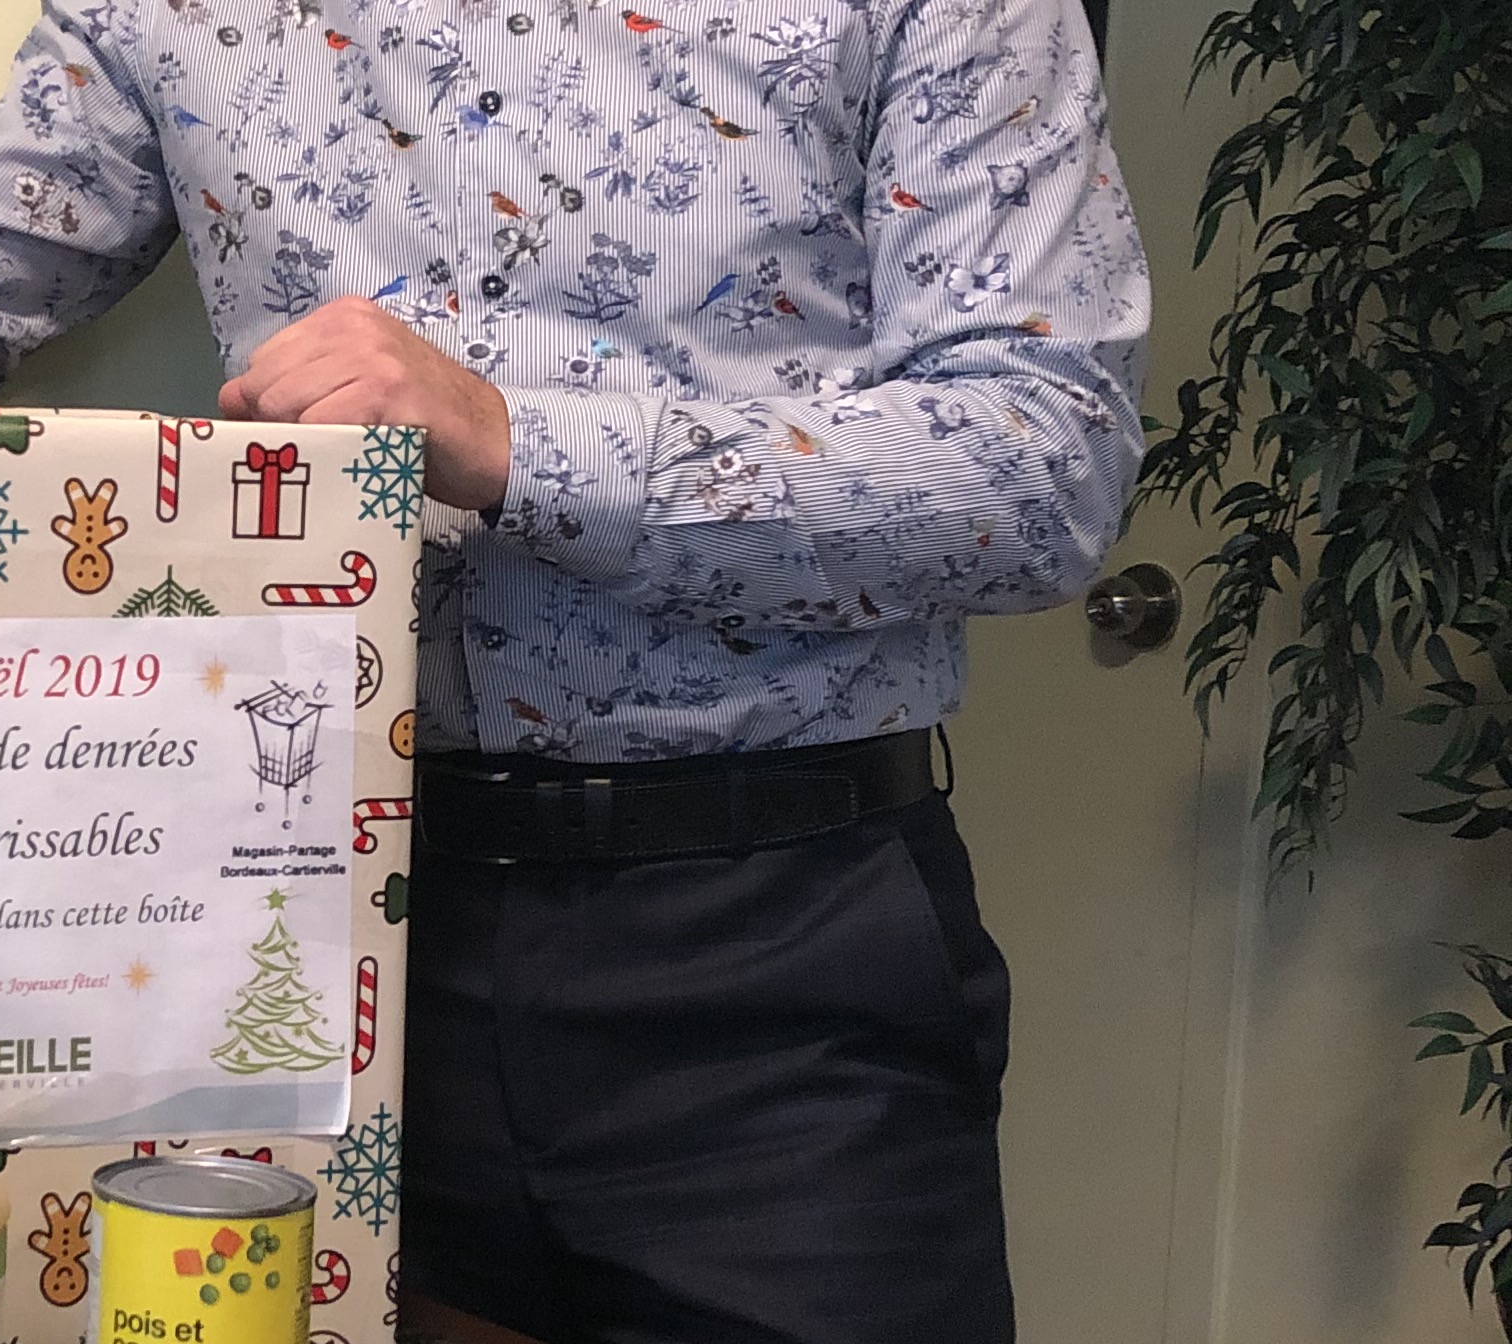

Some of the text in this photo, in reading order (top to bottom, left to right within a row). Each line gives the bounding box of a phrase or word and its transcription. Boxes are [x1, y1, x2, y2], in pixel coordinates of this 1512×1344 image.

[44, 653, 160, 699] 2019
[44, 724, 199, 771] denrées
[231, 844, 337, 859] Magasin-Partage
[220, 864, 346, 878] Bordeaux-Cartierville
[62, 899, 128, 928] cette
[137, 893, 205, 924] boîte
[5, 977, 69, 997] Joyeuses
[113, 1308, 205, 1344] pois et
